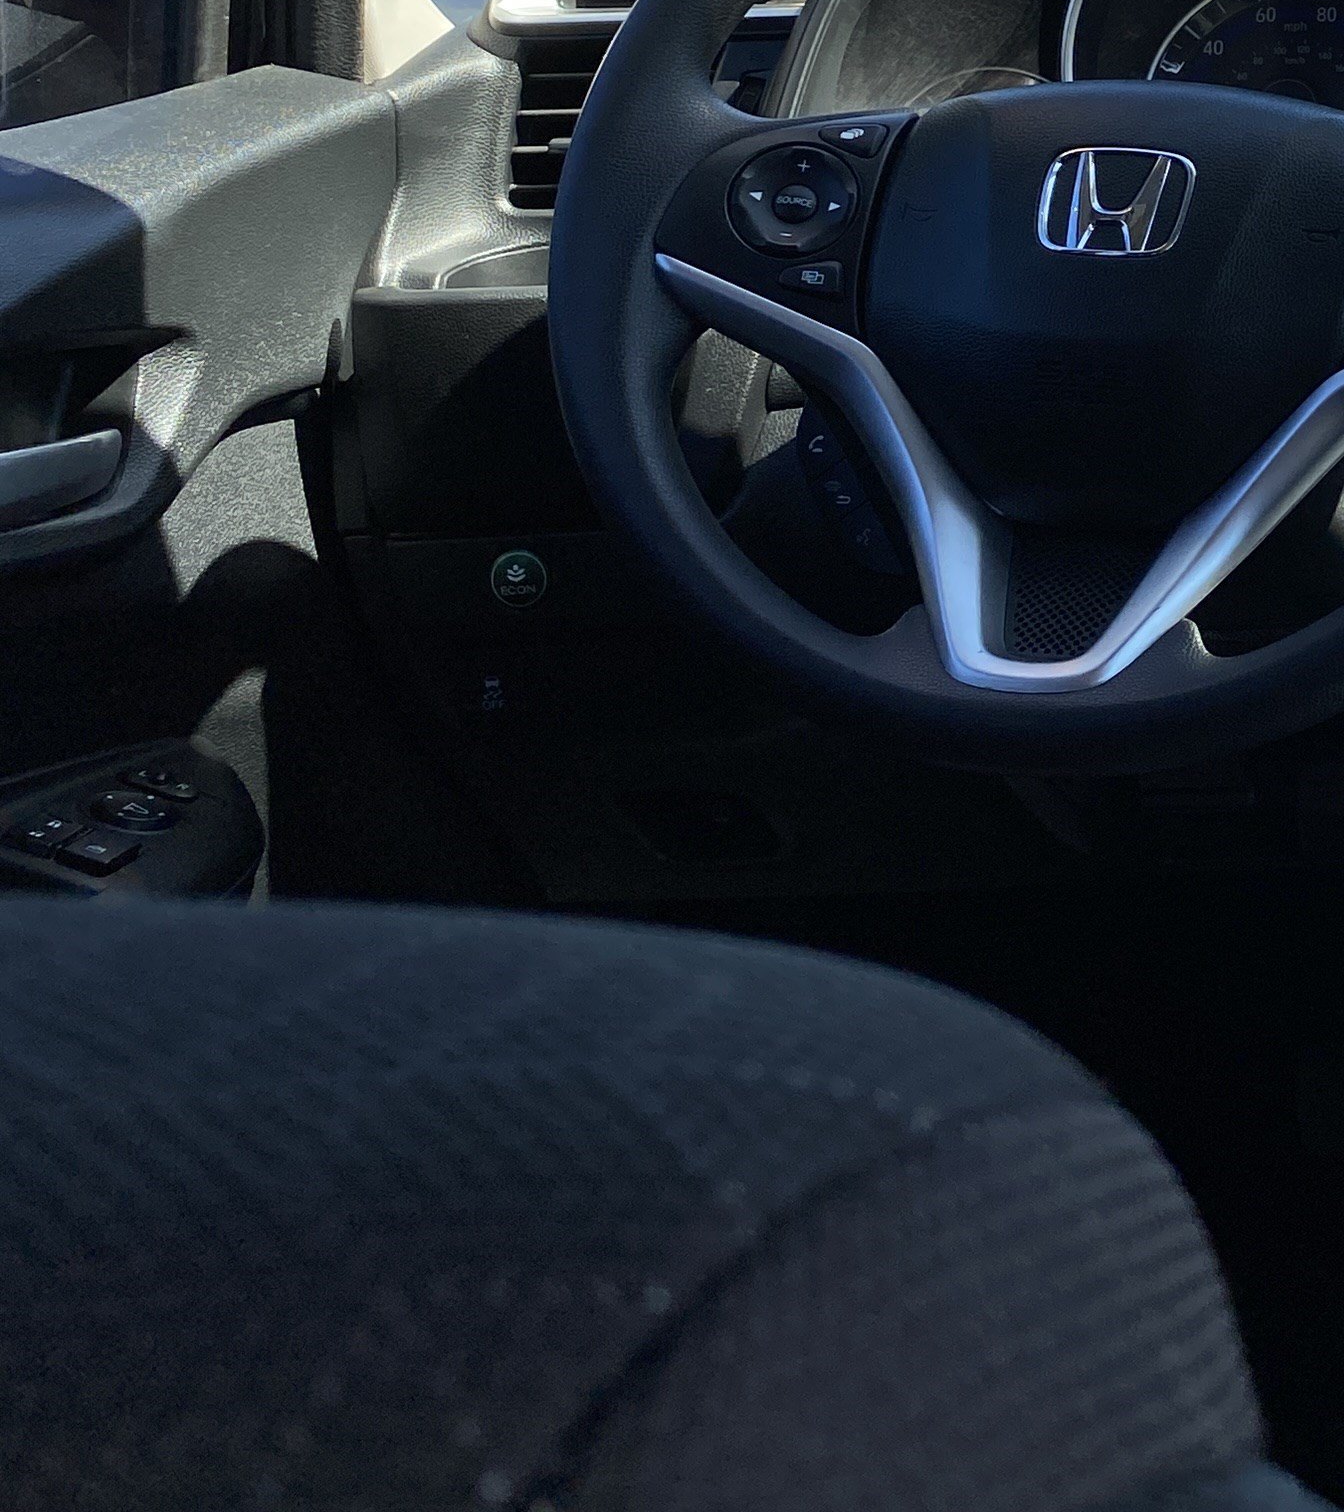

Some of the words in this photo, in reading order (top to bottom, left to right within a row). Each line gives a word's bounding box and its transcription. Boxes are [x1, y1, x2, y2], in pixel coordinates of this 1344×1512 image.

[1255, 7, 1276, 23] 60
[1316, 7, 1337, 23] 80
[1283, 21, 1308, 33] mph
[1203, 39, 1224, 56] 40
[776, 195, 813, 207] SOURCE
[500, 584, 536, 596] ECON
[482, 700, 507, 710] OFF
